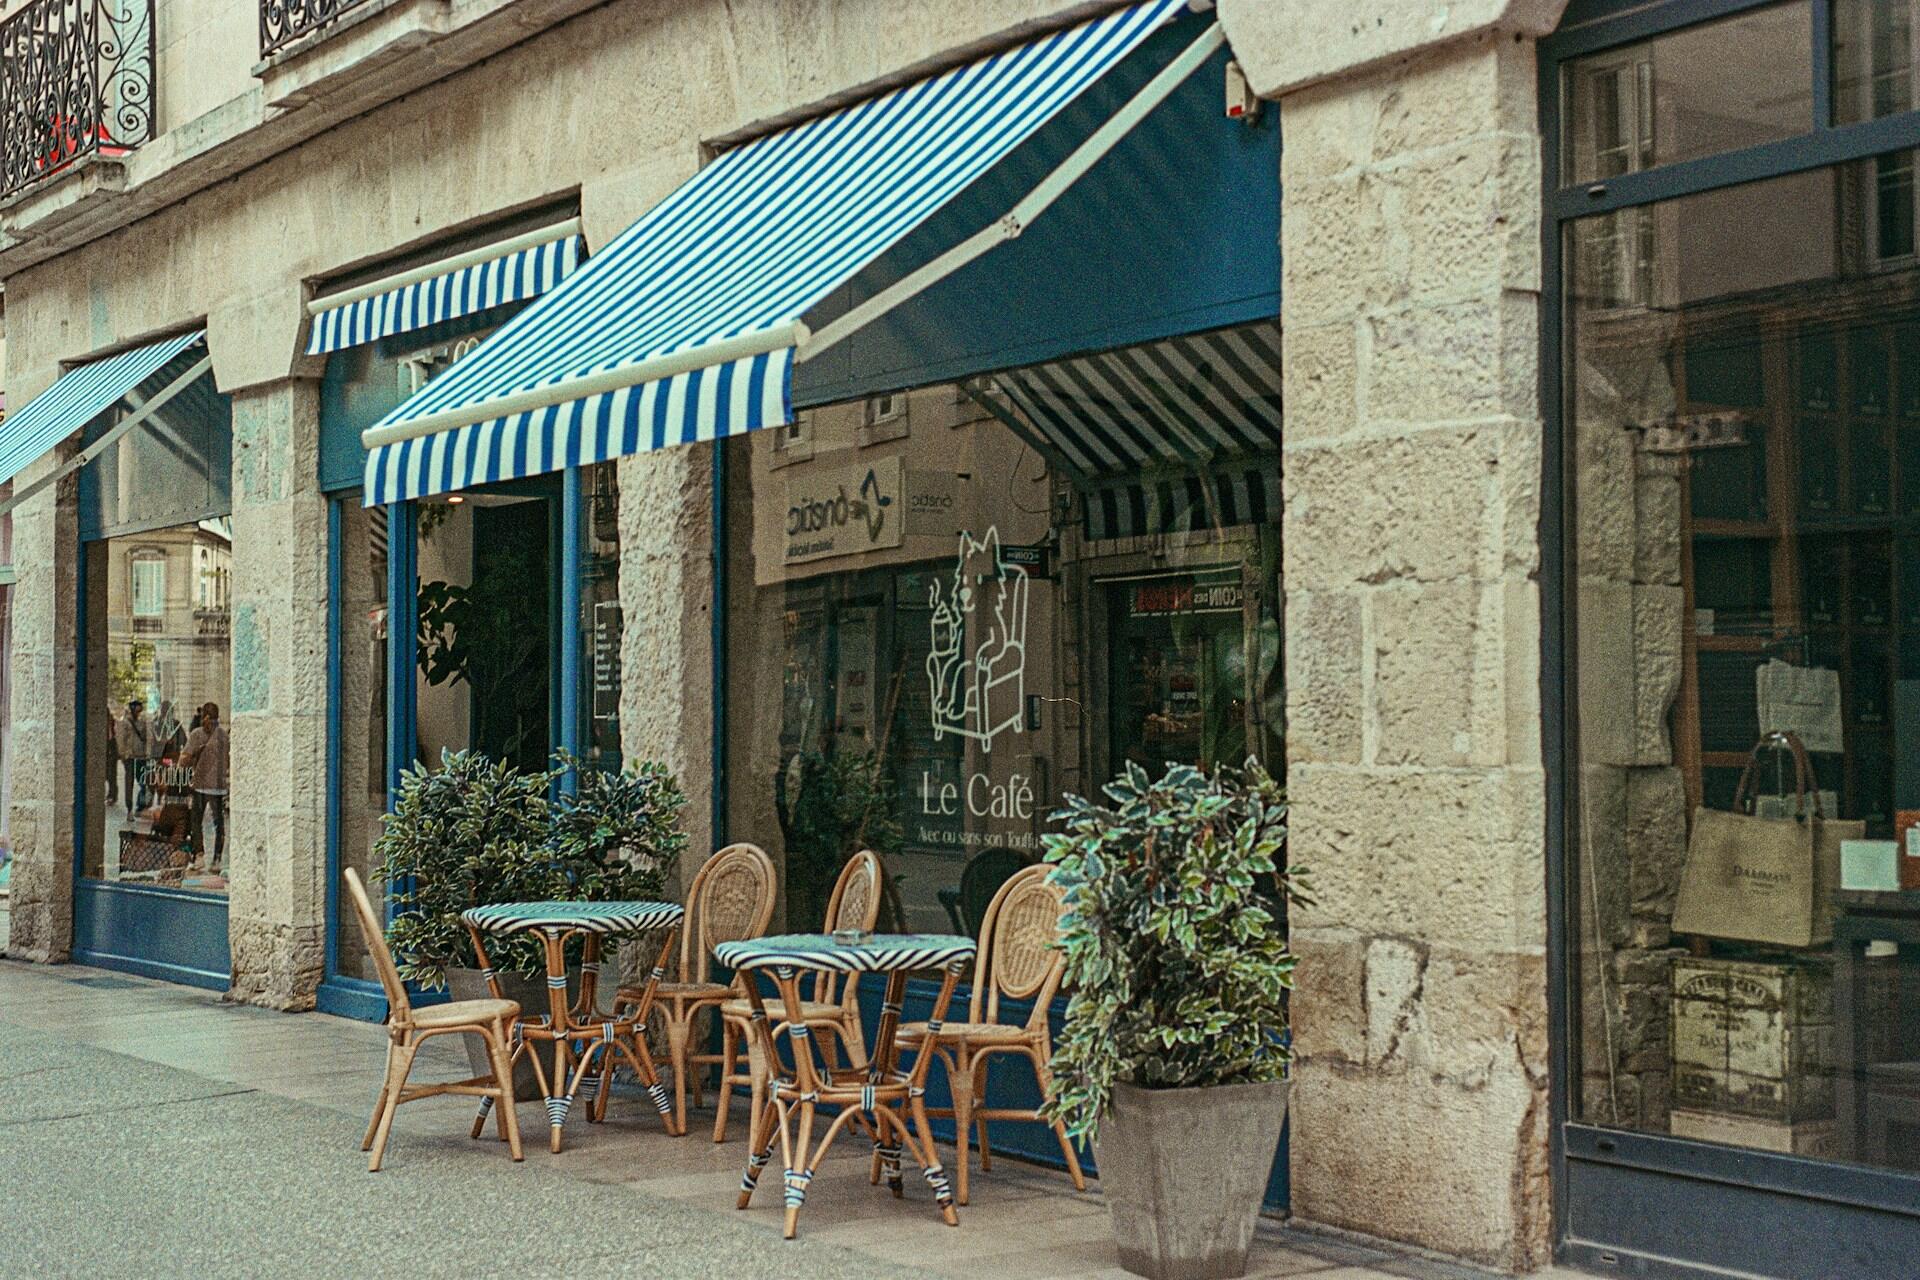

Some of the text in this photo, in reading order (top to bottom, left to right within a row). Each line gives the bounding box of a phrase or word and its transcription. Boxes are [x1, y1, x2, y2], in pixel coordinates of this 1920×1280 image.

[133, 758, 195, 793] La Boutique
[923, 771, 1034, 819] Le Café
[942, 830, 956, 844] ou
[958, 832, 981, 846] sans
[983, 833, 1003, 848] son
